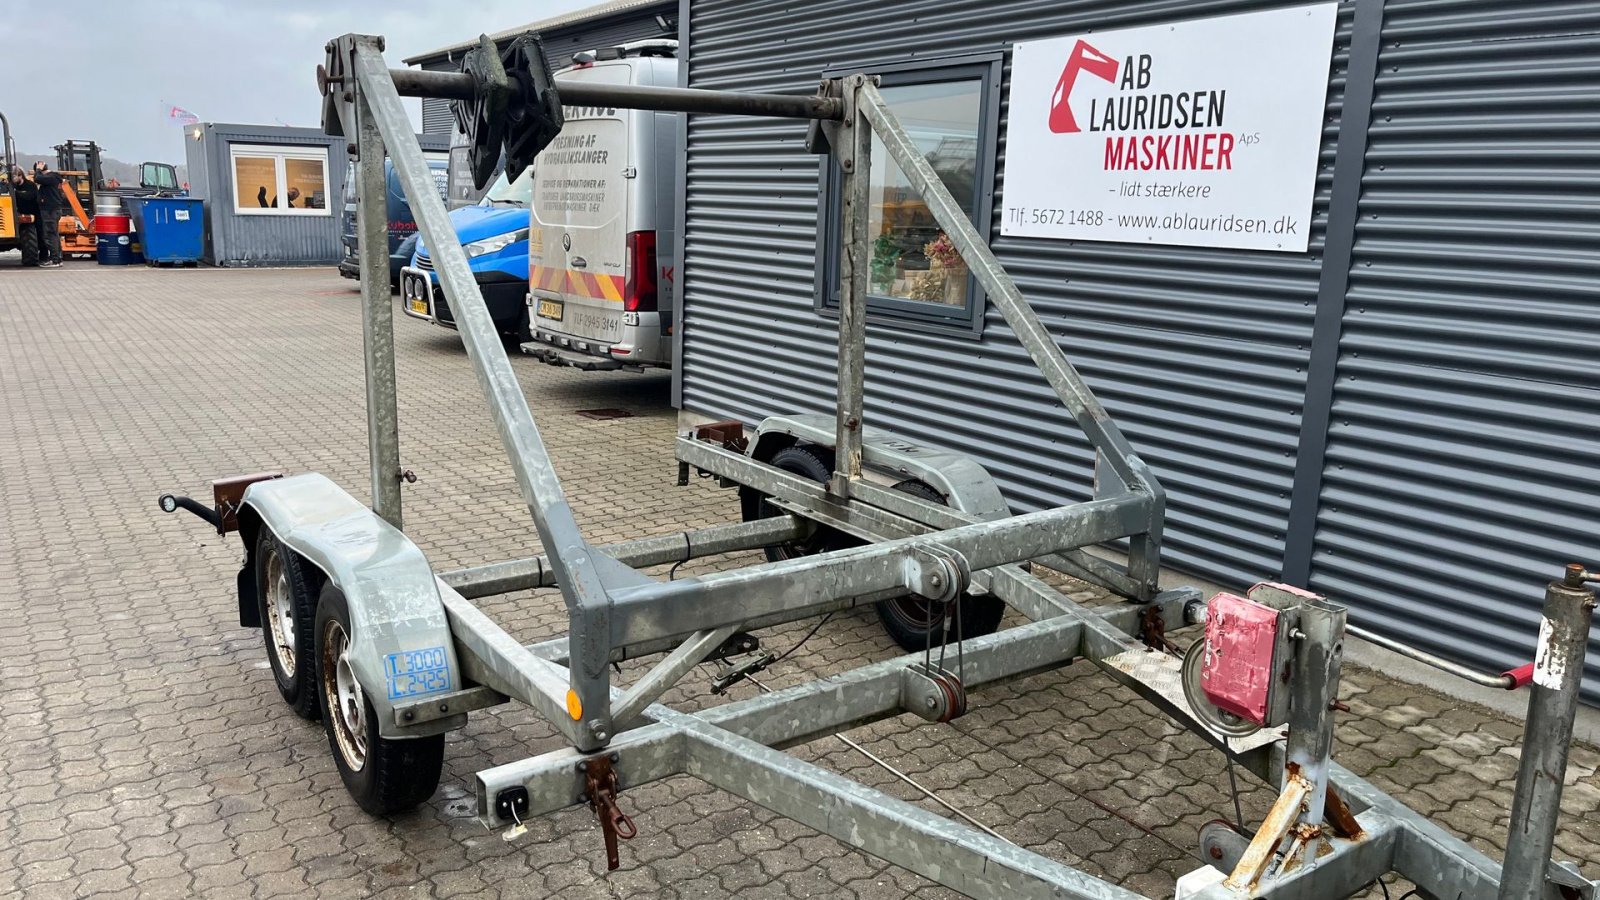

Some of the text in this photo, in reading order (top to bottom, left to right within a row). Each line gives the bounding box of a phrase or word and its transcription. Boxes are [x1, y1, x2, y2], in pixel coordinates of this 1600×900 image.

[1120, 54, 1153, 91] AB
[1089, 90, 1226, 132] LAURIDSEN
[553, 134, 597, 149] PRESNING AF
[1103, 132, 1261, 171] MASKINER ApS
[1119, 181, 1142, 198] lidt
[1145, 182, 1212, 199] stærkere
[1009, 207, 1028, 224] Tlf.
[1031, 208, 1065, 226] 5672
[1067, 210, 1104, 227] 1488
[1117, 212, 1298, 235] www.ablauridsen.dk
